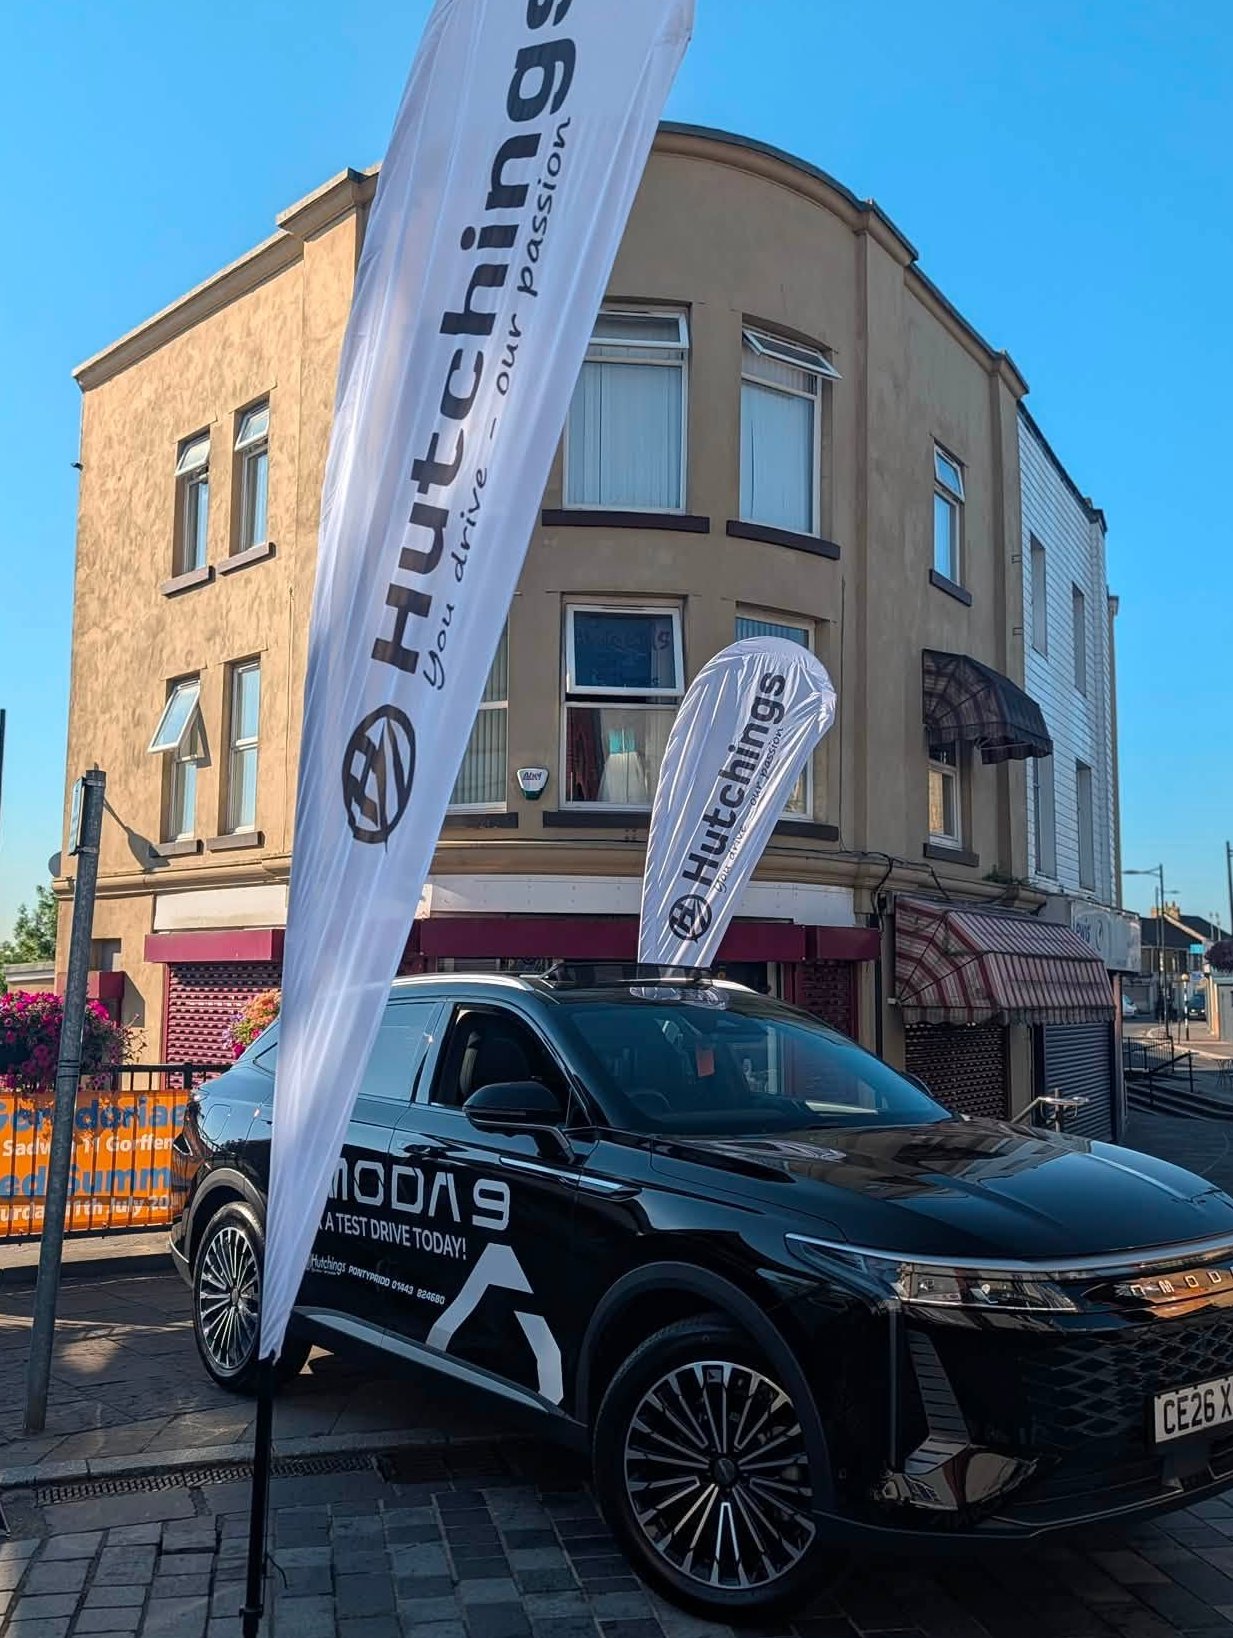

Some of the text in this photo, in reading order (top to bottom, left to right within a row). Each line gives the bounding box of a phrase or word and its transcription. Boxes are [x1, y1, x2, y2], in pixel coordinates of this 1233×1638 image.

[451, 467, 487, 582] drive
[496, 314, 522, 396] our
[517, 117, 571, 297] passion
[682, 671, 786, 888] Hutchings
[750, 782, 763, 806] our
[760, 727, 784, 779] passion
[106, 1134, 173, 1152] Gorffen
[67, 1164, 171, 1196] Summ
[329, 1157, 510, 1231] MODA 9
[0, 1202, 44, 1221] urda
[107, 1196, 144, 1217] July
[148, 1195, 171, 1211] 20
[325, 1212, 467, 1260] A TEST DRIVE TODAY!
[311, 1254, 346, 1273] Hutchings
[348, 1265, 390, 1287] PONTYPRIDD
[391, 1280, 413, 1295] 01443
[1130, 1266, 1233, 1297] OMOD
[1163, 1388, 1215, 1435] CE26
